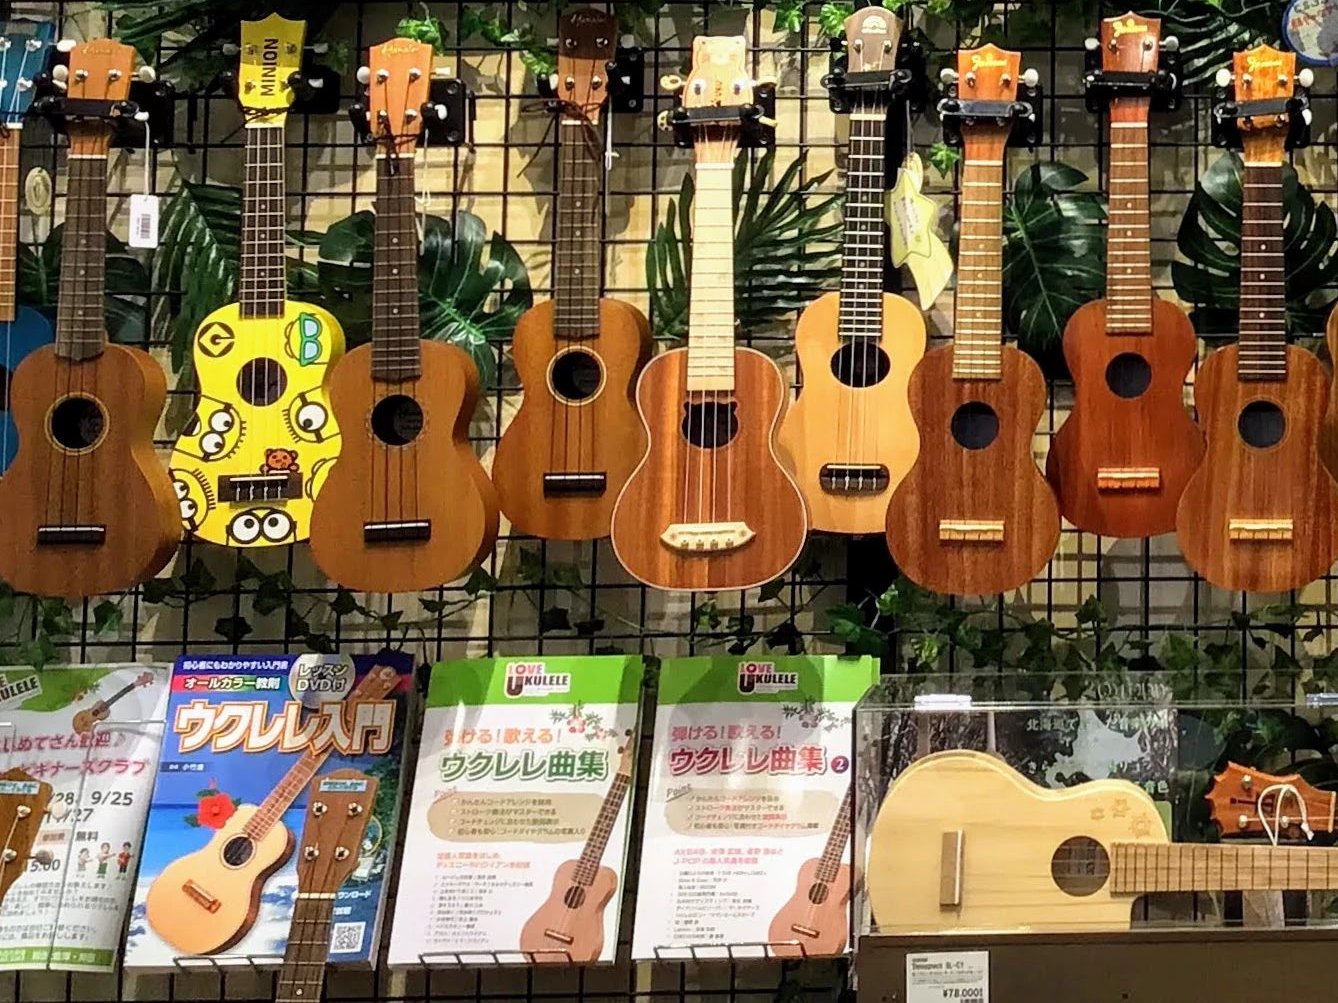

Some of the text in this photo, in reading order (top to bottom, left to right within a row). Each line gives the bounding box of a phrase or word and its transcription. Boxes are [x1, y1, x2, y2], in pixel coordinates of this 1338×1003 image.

[259, 37, 279, 97] MINION
[298, 663, 349, 677] レッスン
[508, 664, 544, 675] LOVE
[0, 676, 39, 702] ULELE
[184, 677, 280, 691] オールカラー教則
[296, 679, 347, 693] DVD付
[506, 675, 569, 697] UKULELE
[739, 673, 798, 694] UKULELE
[174, 699, 398, 756] ウクレレ入門
[0, 731, 111, 753] じめてさん歓迎
[441, 750, 608, 780] ウクレレ曲集
[670, 746, 825, 774] ウクレレ曲集
[91, 790, 134, 806] 9/25
[75, 830, 99, 842] 無料
